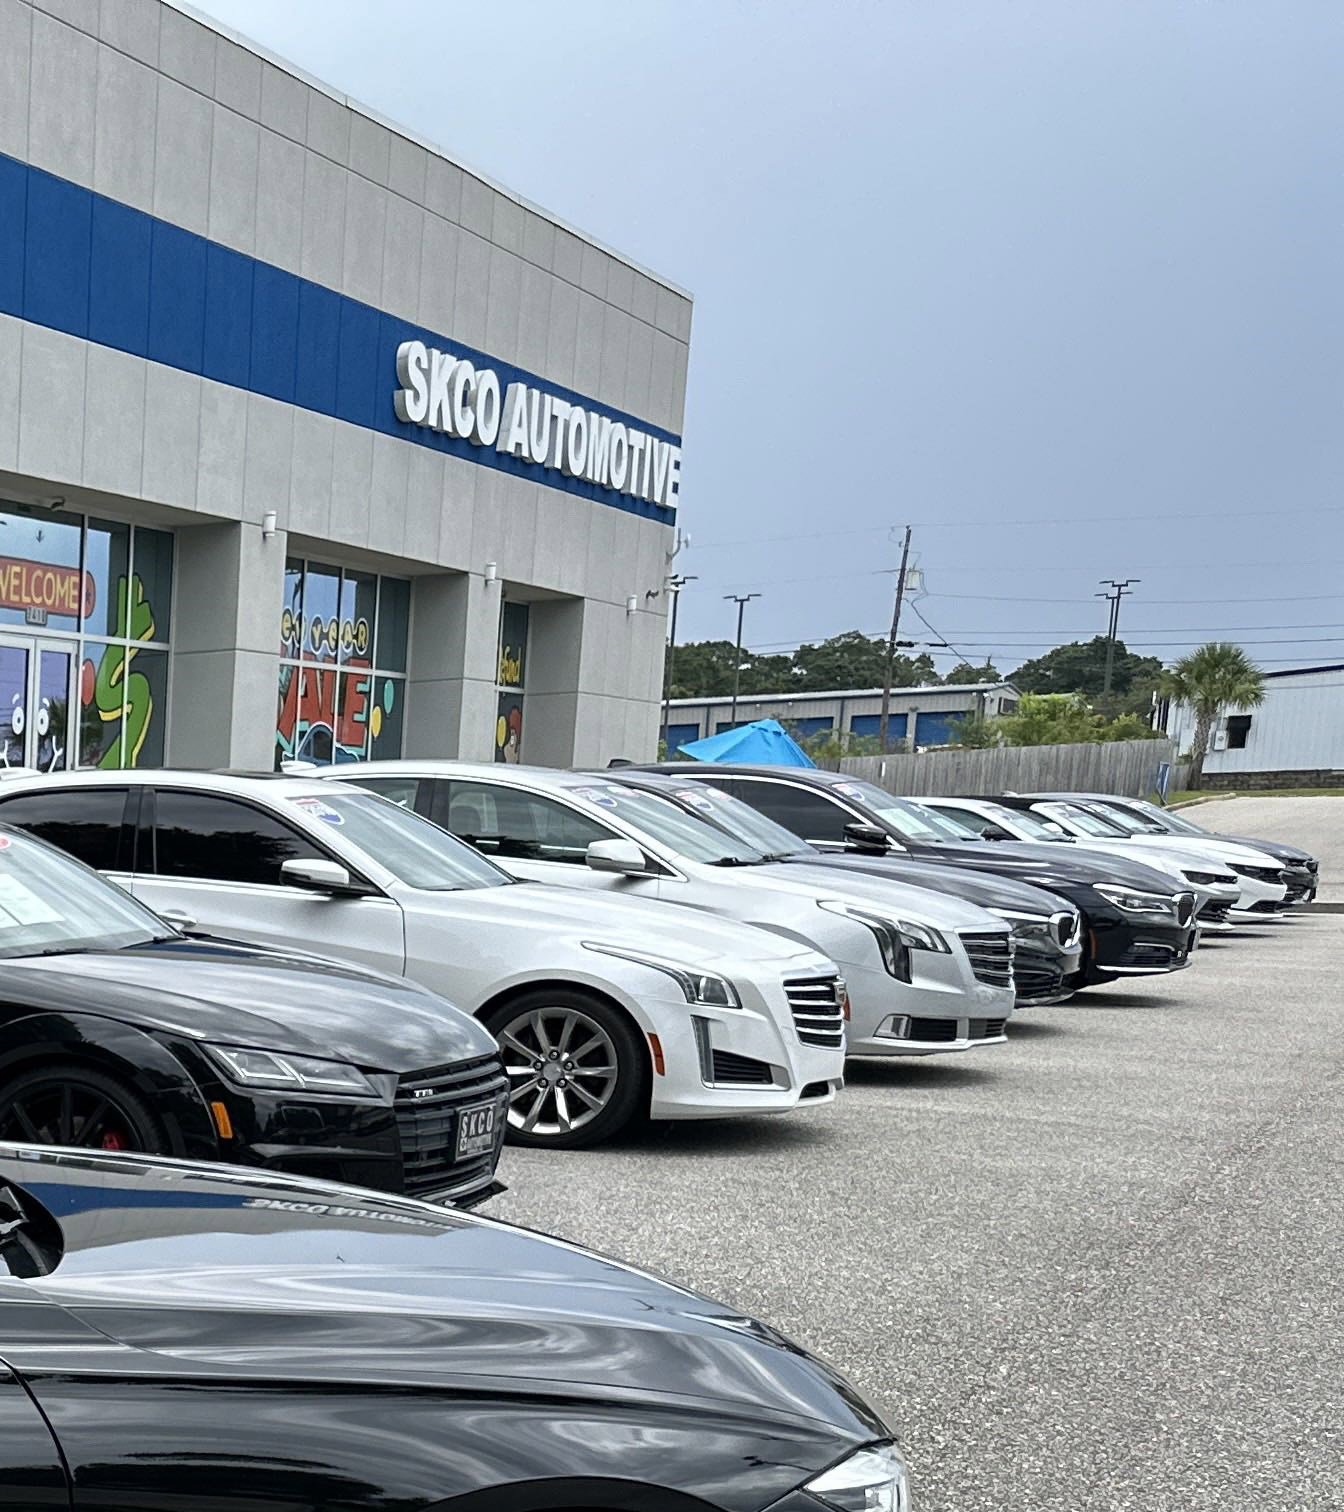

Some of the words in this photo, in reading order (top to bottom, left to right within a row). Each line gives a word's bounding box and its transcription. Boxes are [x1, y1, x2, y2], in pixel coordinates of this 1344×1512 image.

[395, 340, 501, 446] SKCO
[496, 382, 682, 509] AUTOMOTIVE
[277, 650, 370, 748] ALE
[461, 1110, 494, 1138] SKCO
